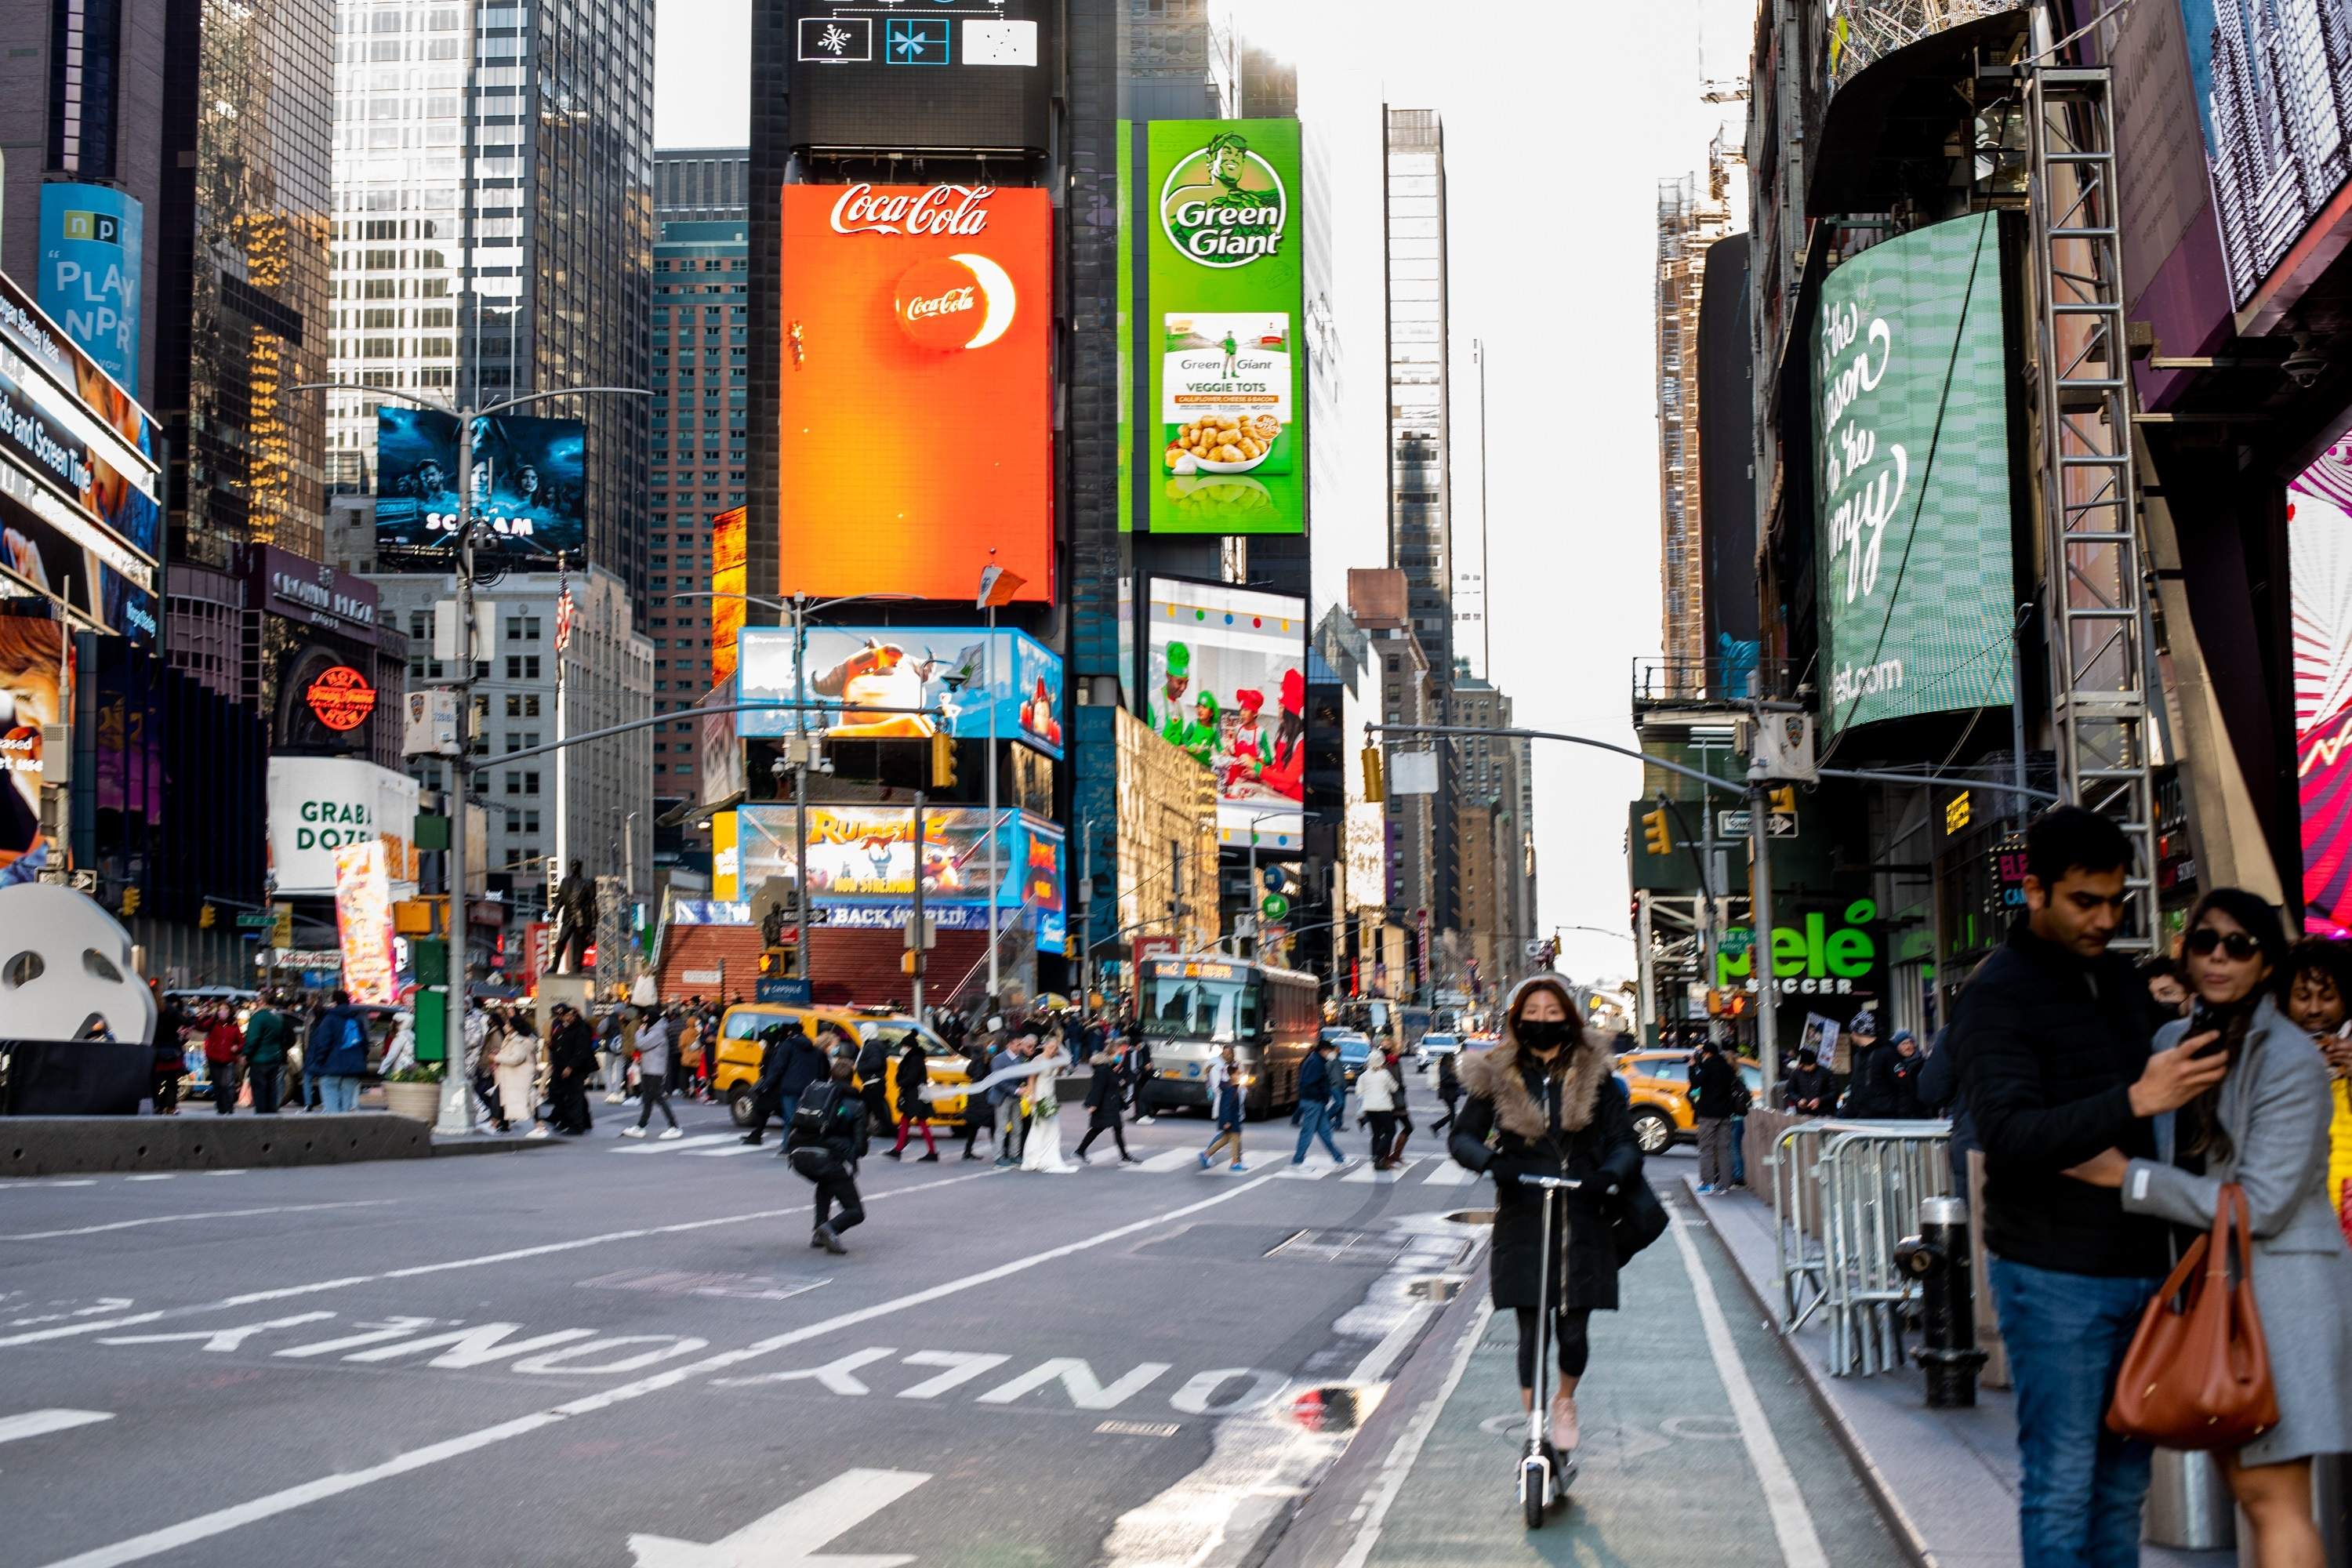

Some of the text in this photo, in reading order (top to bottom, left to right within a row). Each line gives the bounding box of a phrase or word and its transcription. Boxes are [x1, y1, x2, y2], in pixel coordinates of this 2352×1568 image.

[830, 183, 997, 235] Coca-Cola
[1177, 201, 1278, 227] Green
[71, 216, 129, 241] npr
[1189, 228, 1283, 256] Giant
[906, 285, 975, 321] Coca-Cola
[1181, 358, 1273, 370] Green Giant
[1186, 383, 1267, 393] VEGGIE TOTS
[14, 414, 34, 452] and
[34, 421, 67, 477] Screen
[68, 448, 92, 495] Time
[425, 513, 534, 537] SCAM
[16, 759, 43, 772] use
[301, 800, 365, 824] GRAB
[834, 908, 891, 929] BACK,
[1717, 898, 1876, 987] pelé
[1745, 978, 1853, 994] SCCER
[708, 1346, 1294, 1414] ONLY
